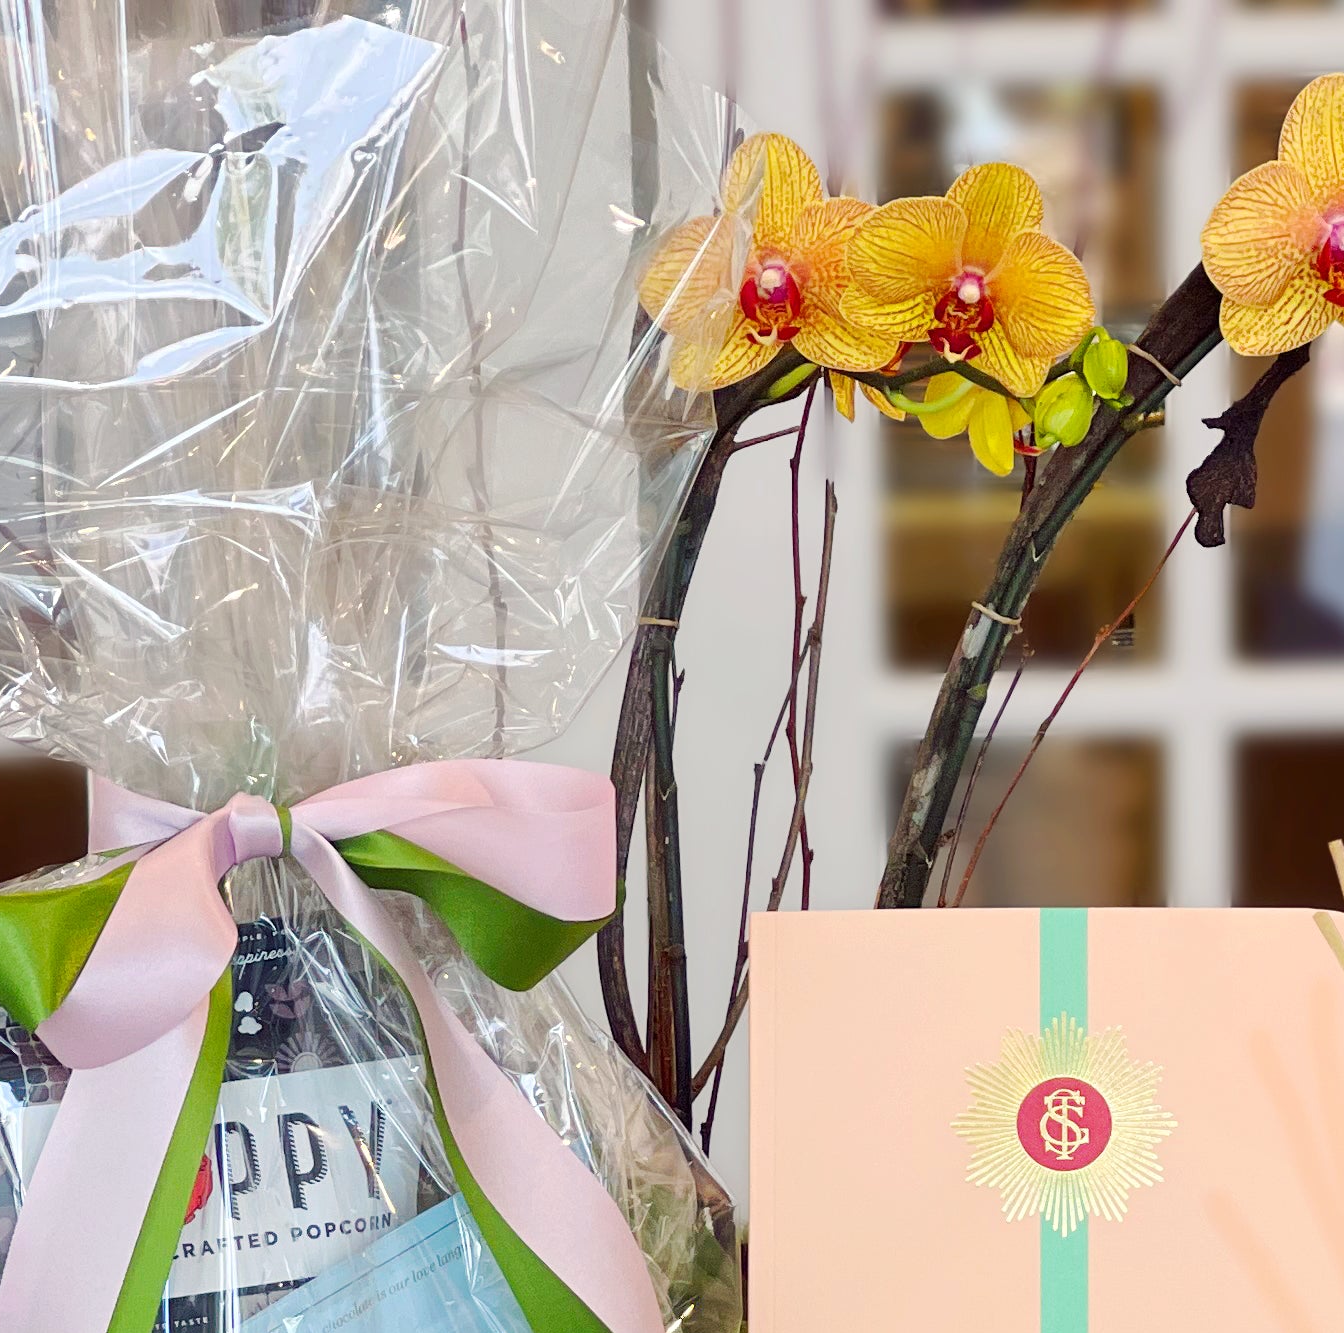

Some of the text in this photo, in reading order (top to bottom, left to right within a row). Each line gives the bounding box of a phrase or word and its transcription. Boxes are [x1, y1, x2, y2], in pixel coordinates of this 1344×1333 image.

[291, 1212, 392, 1243] POPCORN
[376, 1287, 387, 1302] is
[388, 1276, 410, 1294] our
[412, 1261, 436, 1283] love
[174, 1316, 209, 1328] TASTE
